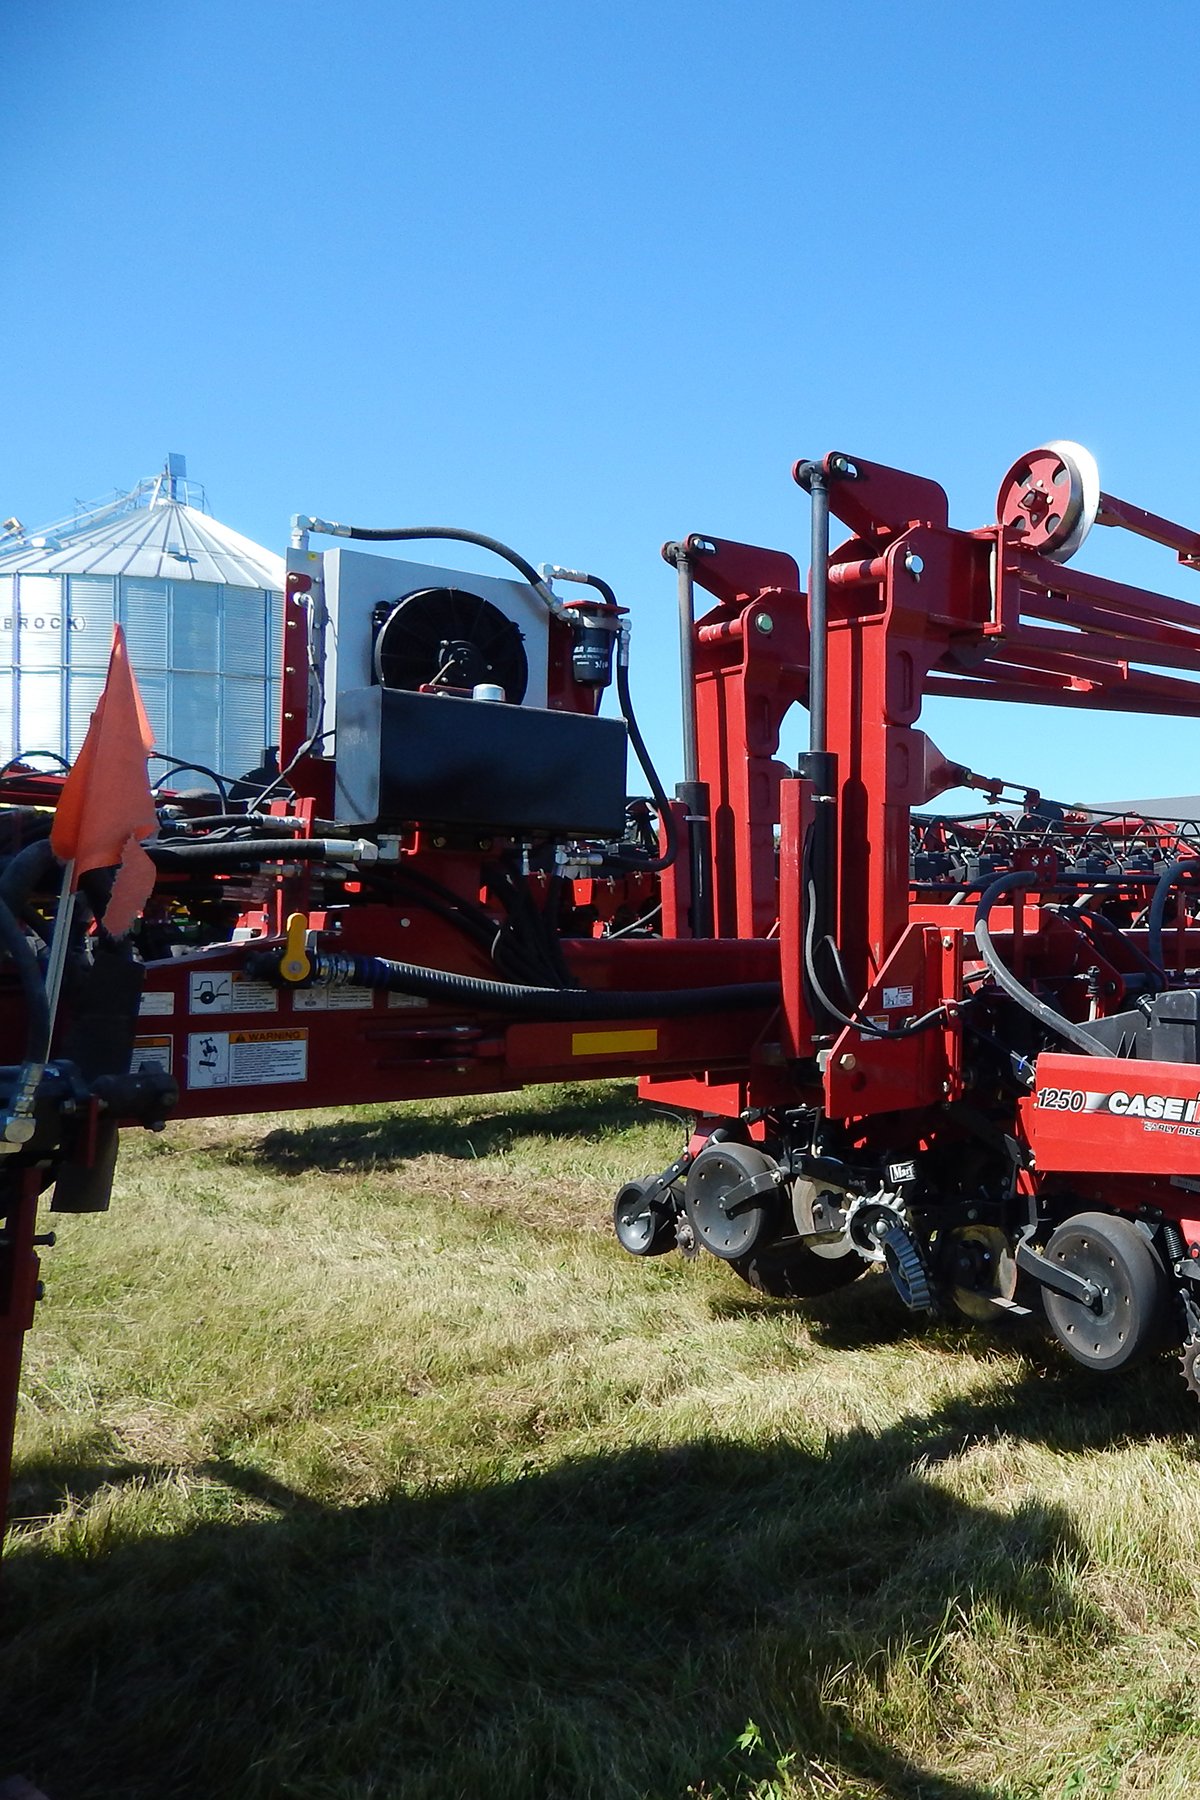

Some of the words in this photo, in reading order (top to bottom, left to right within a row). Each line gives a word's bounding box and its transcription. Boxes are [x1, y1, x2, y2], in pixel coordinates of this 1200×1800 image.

[4, 617, 78, 630] BROCK
[248, 1031, 300, 1041] WARNING
[1037, 1089, 1086, 1112] 1250
[1108, 1092, 1182, 1120] CASE
[1144, 1122, 1175, 1134] EARLY
